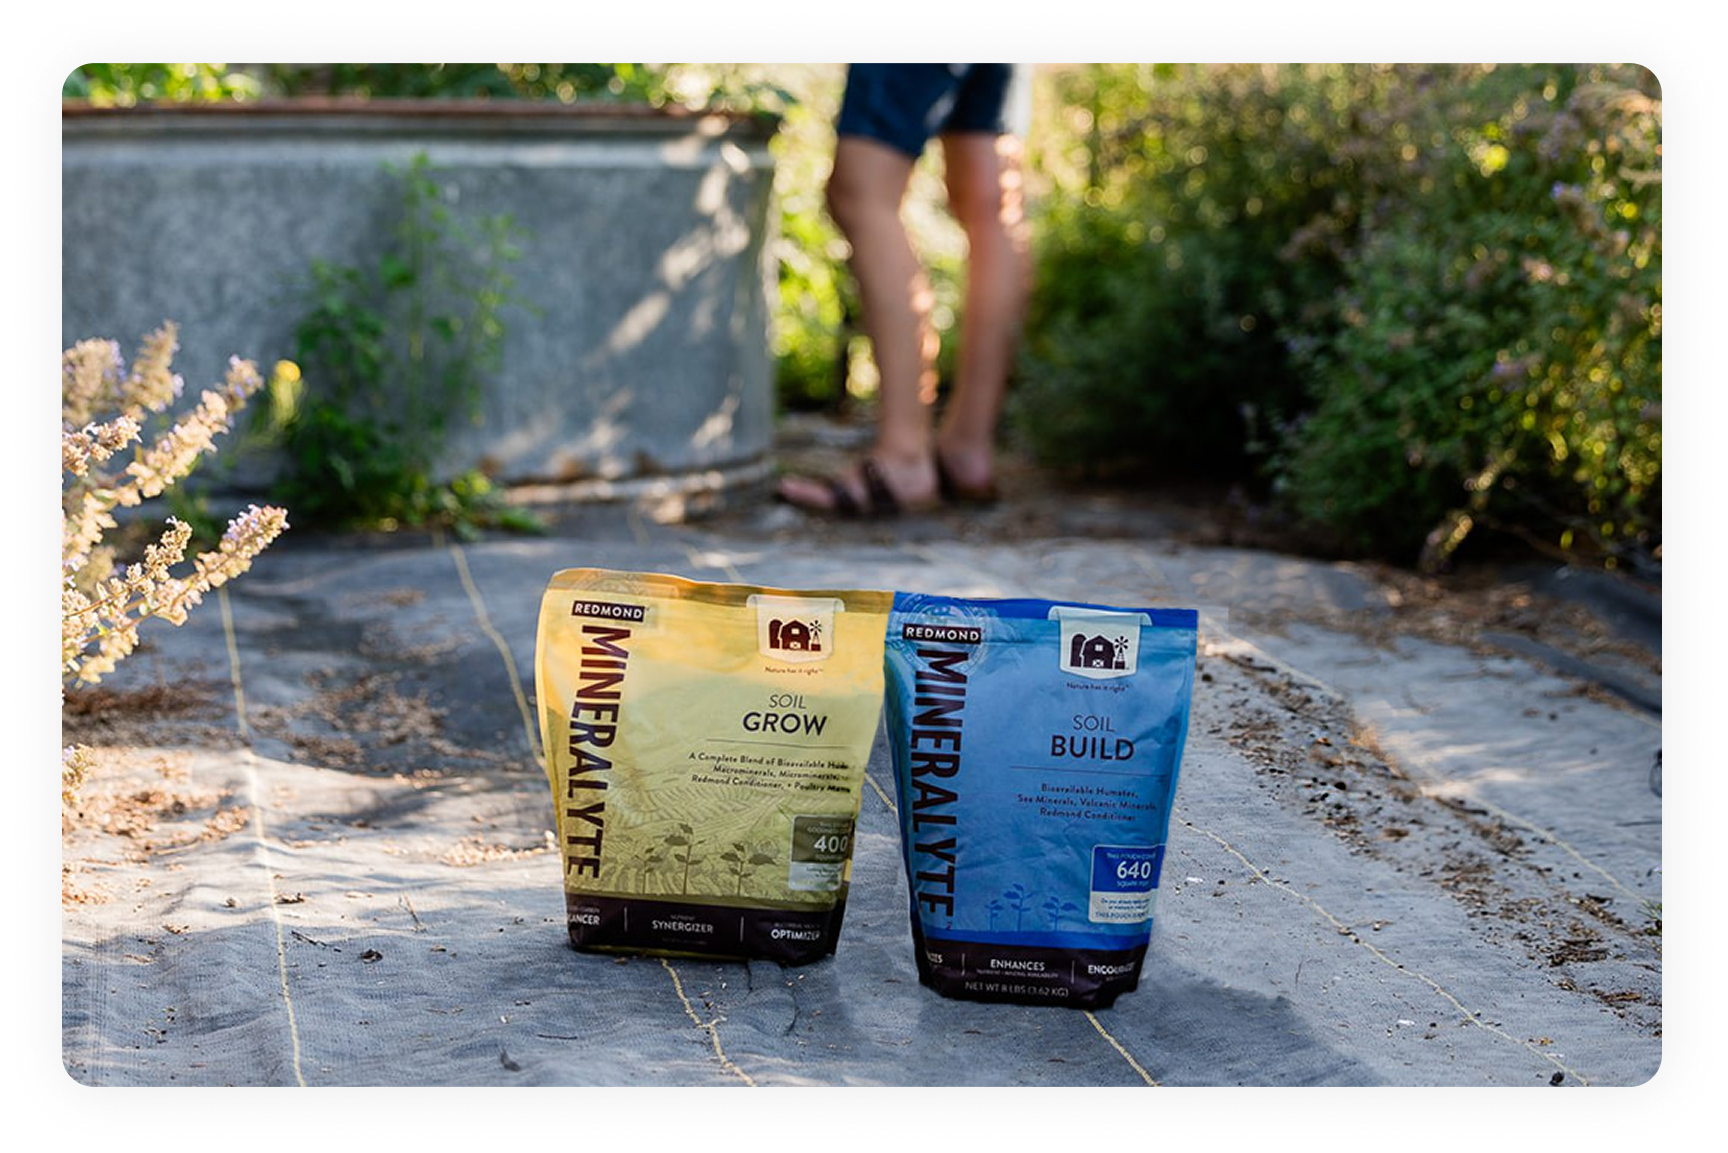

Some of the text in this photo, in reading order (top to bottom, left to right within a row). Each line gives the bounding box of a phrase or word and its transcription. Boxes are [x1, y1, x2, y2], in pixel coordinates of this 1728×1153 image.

[574, 603, 643, 619] REDMOND
[906, 626, 980, 641] REDMOND
[765, 666, 786, 674] Nature
[1067, 682, 1089, 690] Nature
[769, 694, 807, 709] SOIL
[743, 712, 827, 735] GROW
[1073, 714, 1116, 732] SOIL
[567, 625, 631, 878] MINERALYTE
[1051, 735, 1134, 761] BUILD
[689, 752, 696, 760] A
[698, 752, 738, 764] Complete
[740, 755, 764, 765] Blend
[765, 757, 775, 766] of
[777, 758, 825, 769] Bioavailable
[713, 764, 777, 778] Macrominerals,
[692, 774, 730, 785] Redmond
[732, 777, 784, 790] Conditioner,
[794, 781, 825, 792] Poultry
[911, 649, 969, 917] MINERALYTE
[1041, 783, 1139, 799] Bioavailable Humates,
[1018, 794, 1033, 803] Sea
[1035, 795, 1077, 807] Minerals,
[1080, 798, 1116, 809] Volcanic
[1040, 807, 1081, 819] Redmond
[814, 835, 849, 853] 400
[1117, 860, 1151, 879] 640
[652, 920, 714, 934] SYNERGIZER
[771, 928, 820, 940] OPTIMIZER
[990, 959, 1045, 971] ENHANCES
[965, 981, 983, 991] NET
[985, 982, 1000, 992] WT
[1001, 984, 1008, 993] 8
[1009, 984, 1026, 994] LBS
